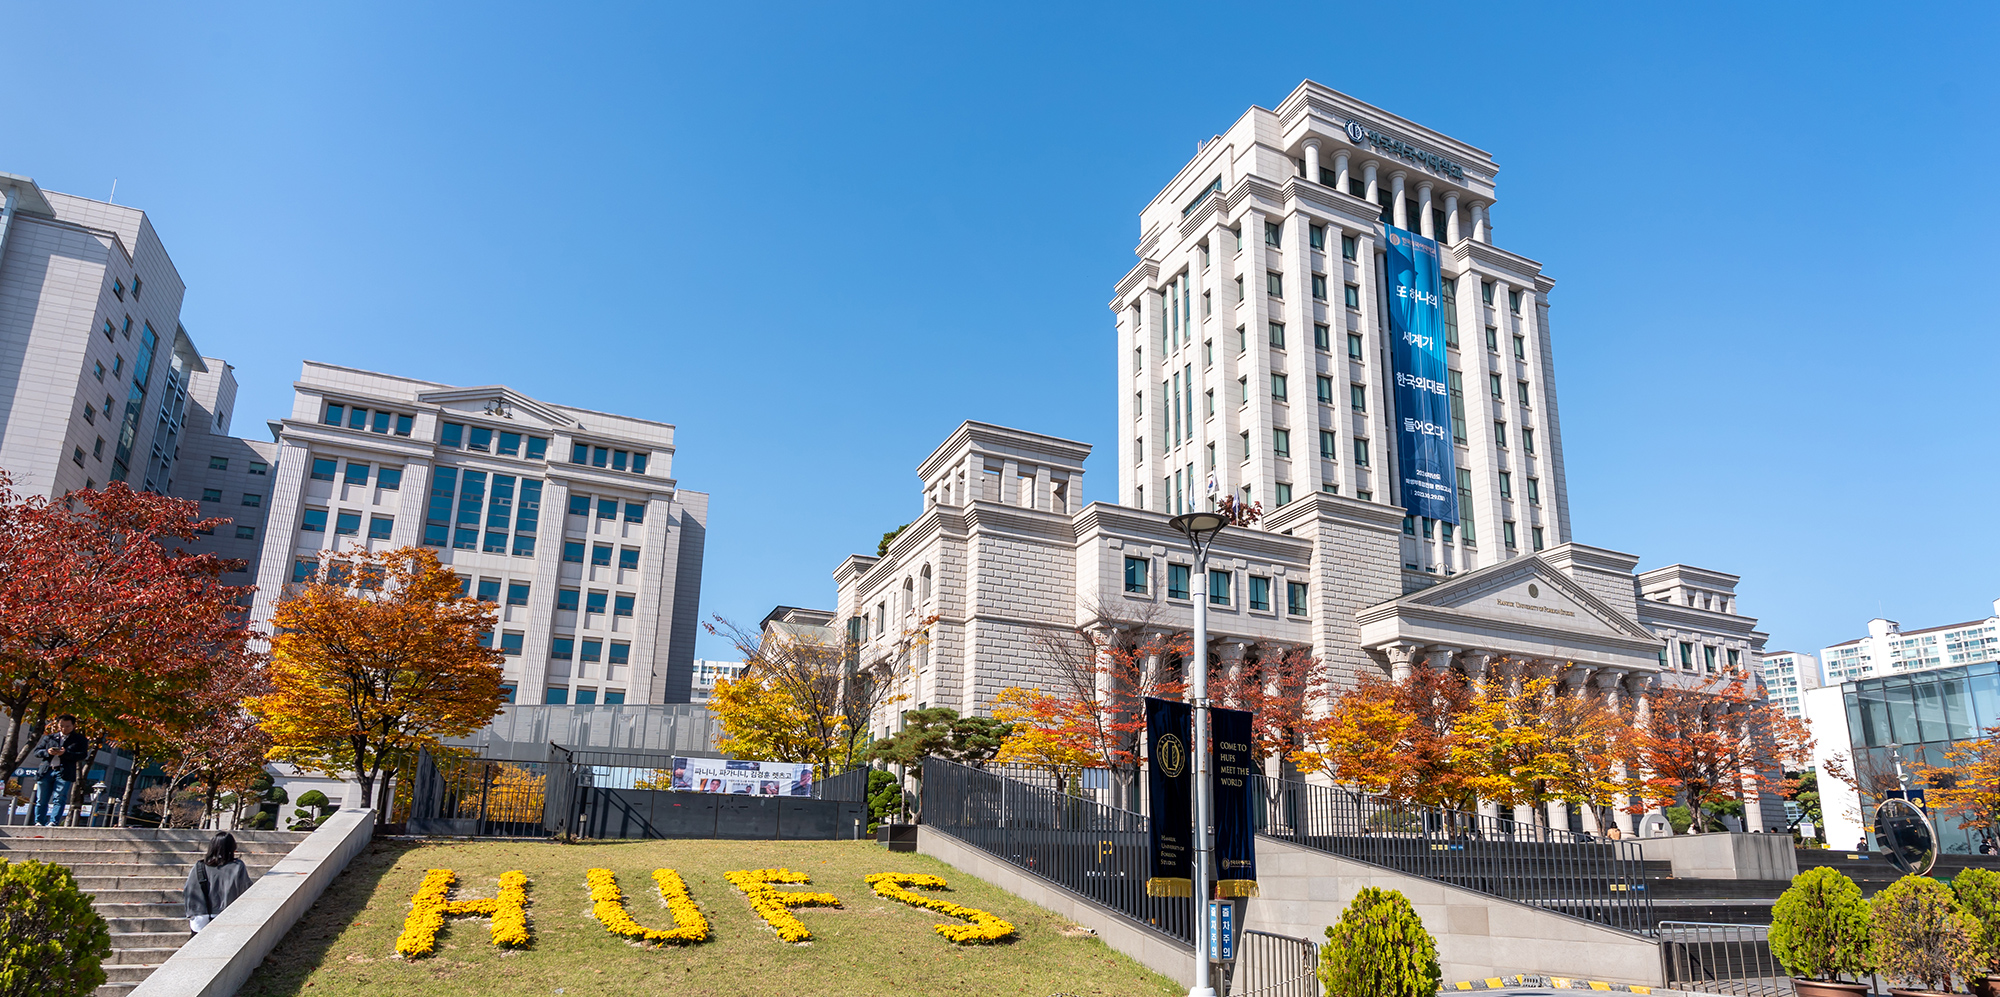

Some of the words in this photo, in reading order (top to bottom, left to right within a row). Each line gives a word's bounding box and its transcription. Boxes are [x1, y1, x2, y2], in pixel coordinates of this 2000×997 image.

[1368, 130, 1464, 180] 한국외국어대학교
[1396, 285, 1407, 298] 또
[1409, 288, 1438, 309] 하나의
[1402, 331, 1434, 351] 세계가
[1396, 372, 1447, 396] 한국외대로
[1404, 417, 1445, 440] 들어오다
[1220, 741, 1237, 751] COME
[1237, 743, 1247, 752] TO
[1220, 753, 1236, 762] HUFS
[694, 768, 717, 777] 파니니,
[719, 769, 749, 778] 파가니니,
[1220, 766, 1236, 774] MEET
[1237, 767, 1249, 775] THE
[1220, 778, 1243, 787] WORLD
[395, 868, 1016, 958] HUFS
[1222, 907, 1231, 957] 출차주의
